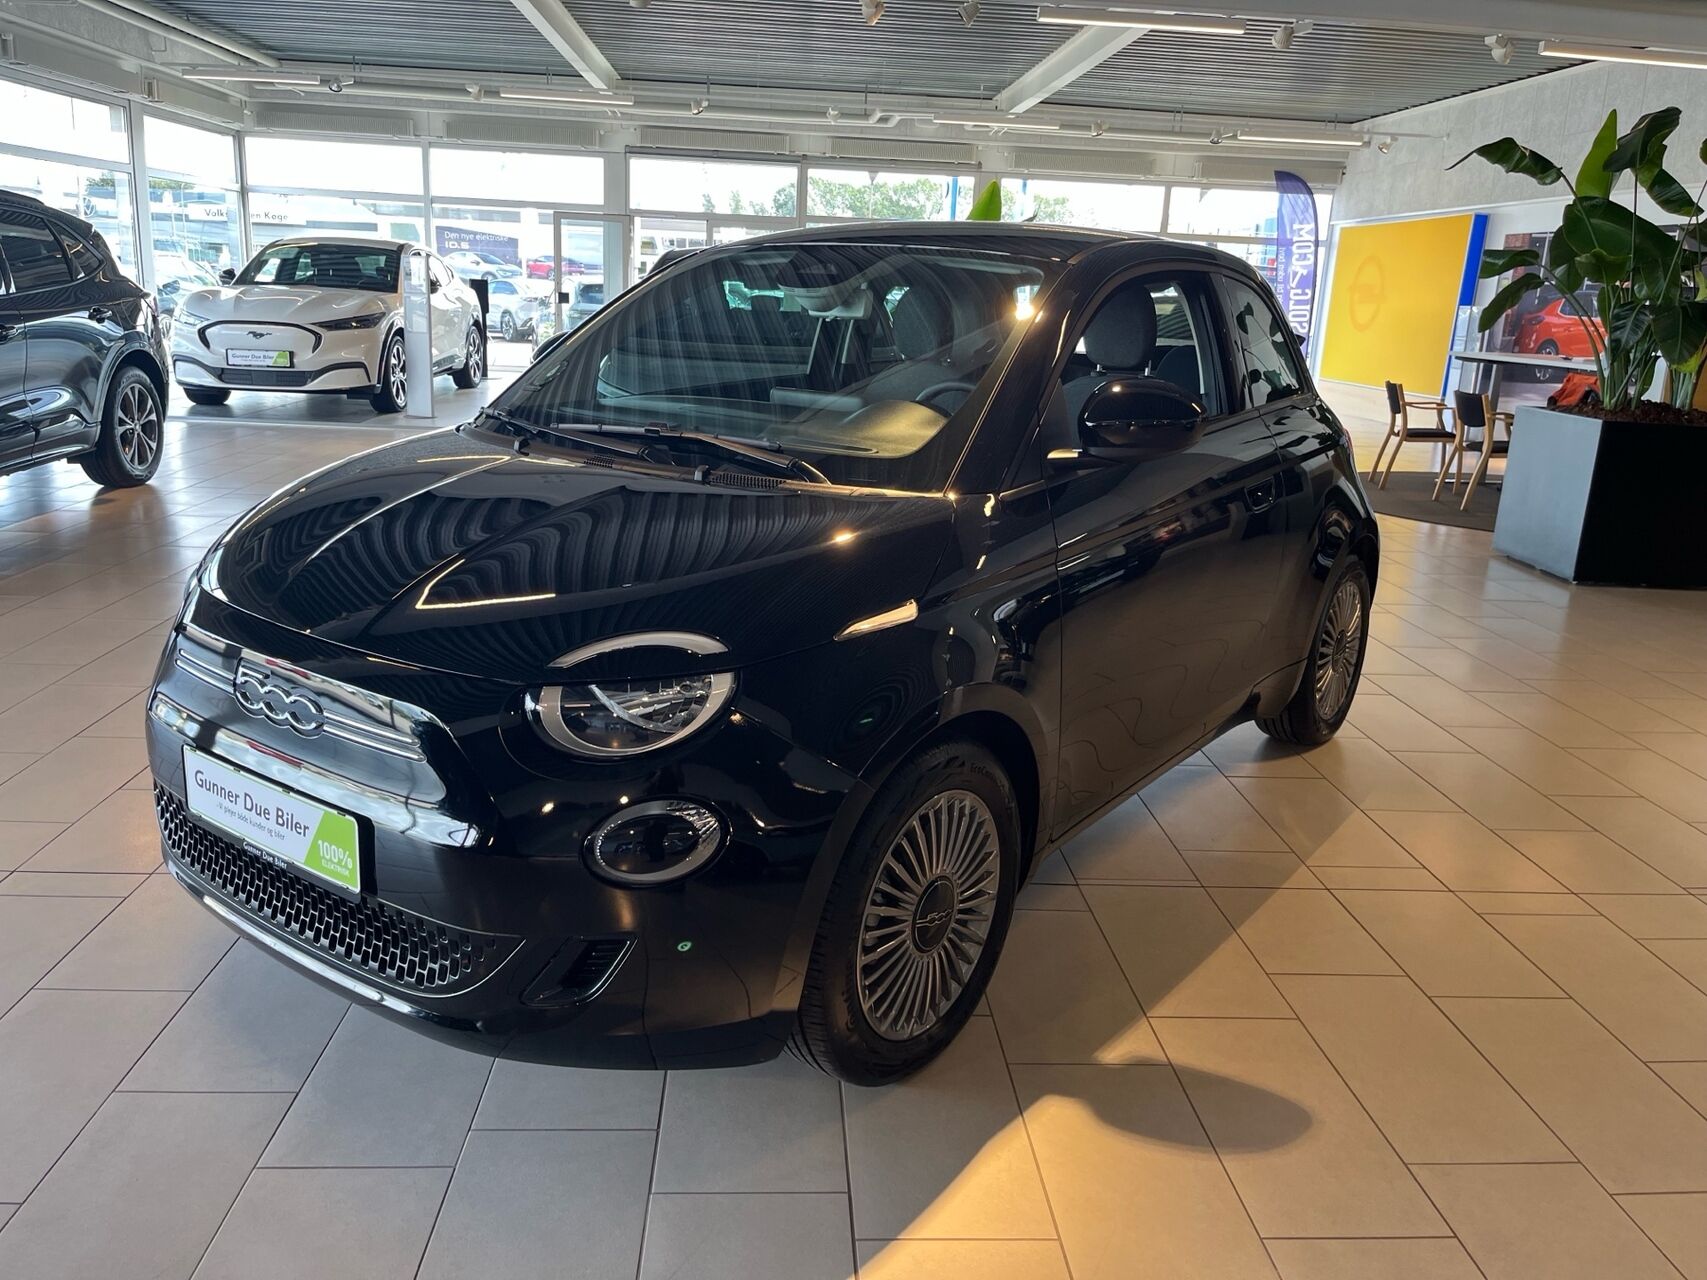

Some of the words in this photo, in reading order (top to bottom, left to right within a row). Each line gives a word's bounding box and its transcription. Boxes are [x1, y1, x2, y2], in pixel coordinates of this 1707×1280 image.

[444, 231, 459, 239] Den
[461, 233, 475, 241] nye
[235, 658, 326, 738] 500
[194, 769, 240, 806] Gunner
[243, 793, 271, 821] Due
[275, 806, 310, 838] Biler
[242, 841, 261, 857] Gunner
[262, 851, 274, 864] Due
[274, 855, 288, 869] Biler
[318, 839, 353, 869] 100%
